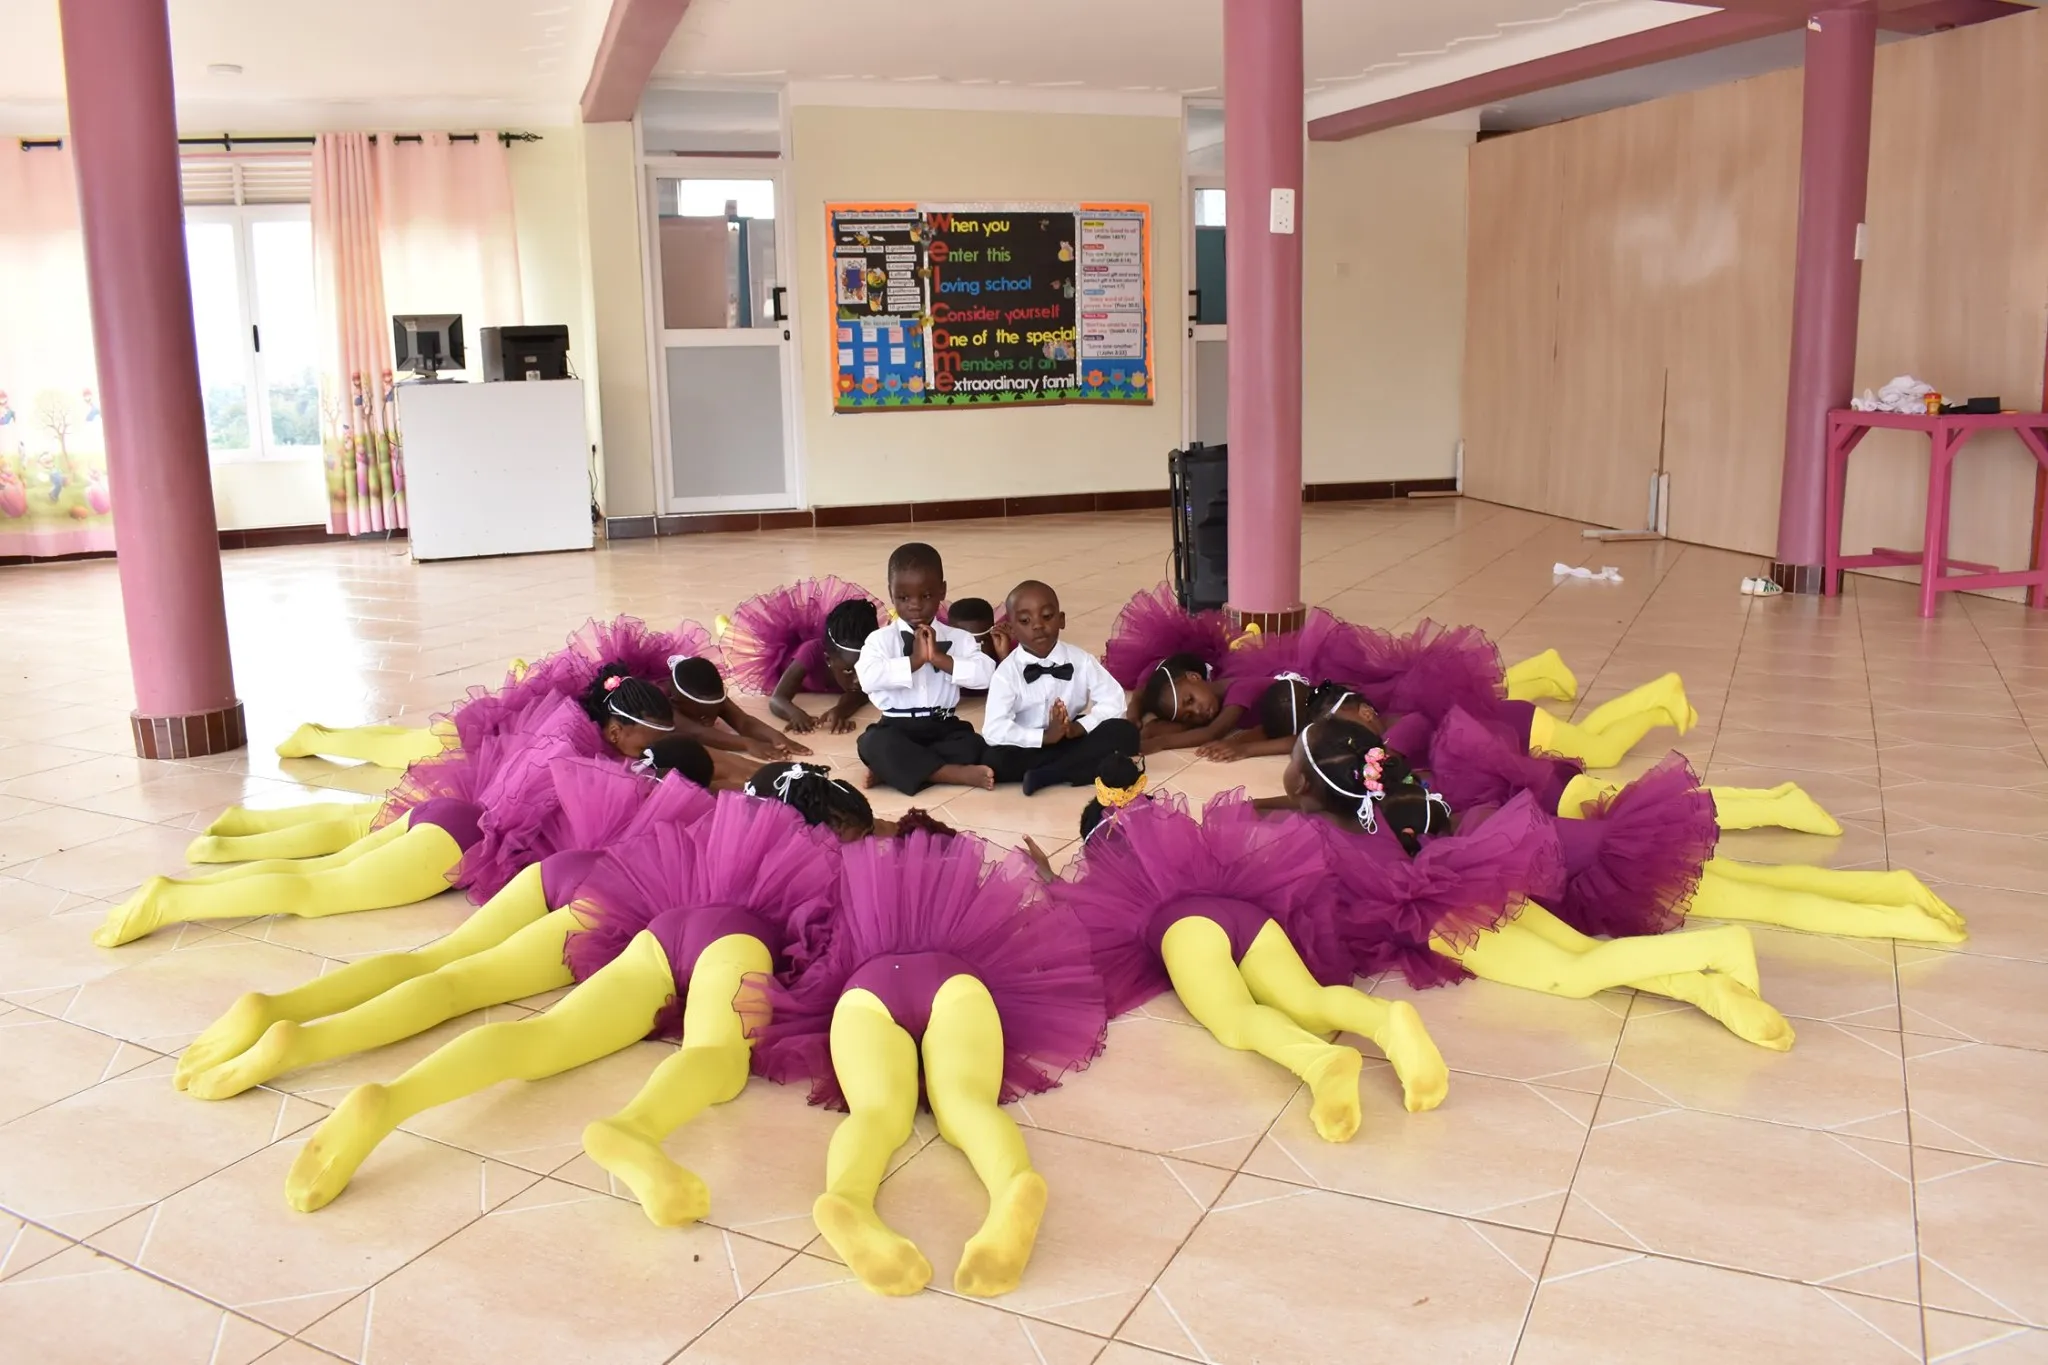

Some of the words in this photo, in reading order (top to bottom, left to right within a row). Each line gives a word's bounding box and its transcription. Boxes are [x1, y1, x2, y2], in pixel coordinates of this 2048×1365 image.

[982, 219, 1010, 237] you
[987, 246, 1011, 262] this
[985, 275, 1032, 291] school
[1004, 304, 1060, 326] yourself
[972, 330, 988, 346] of
[996, 328, 1019, 344] the
[1026, 326, 1076, 346] special
[1019, 357, 1034, 370] of
[1038, 358, 1056, 371] an
